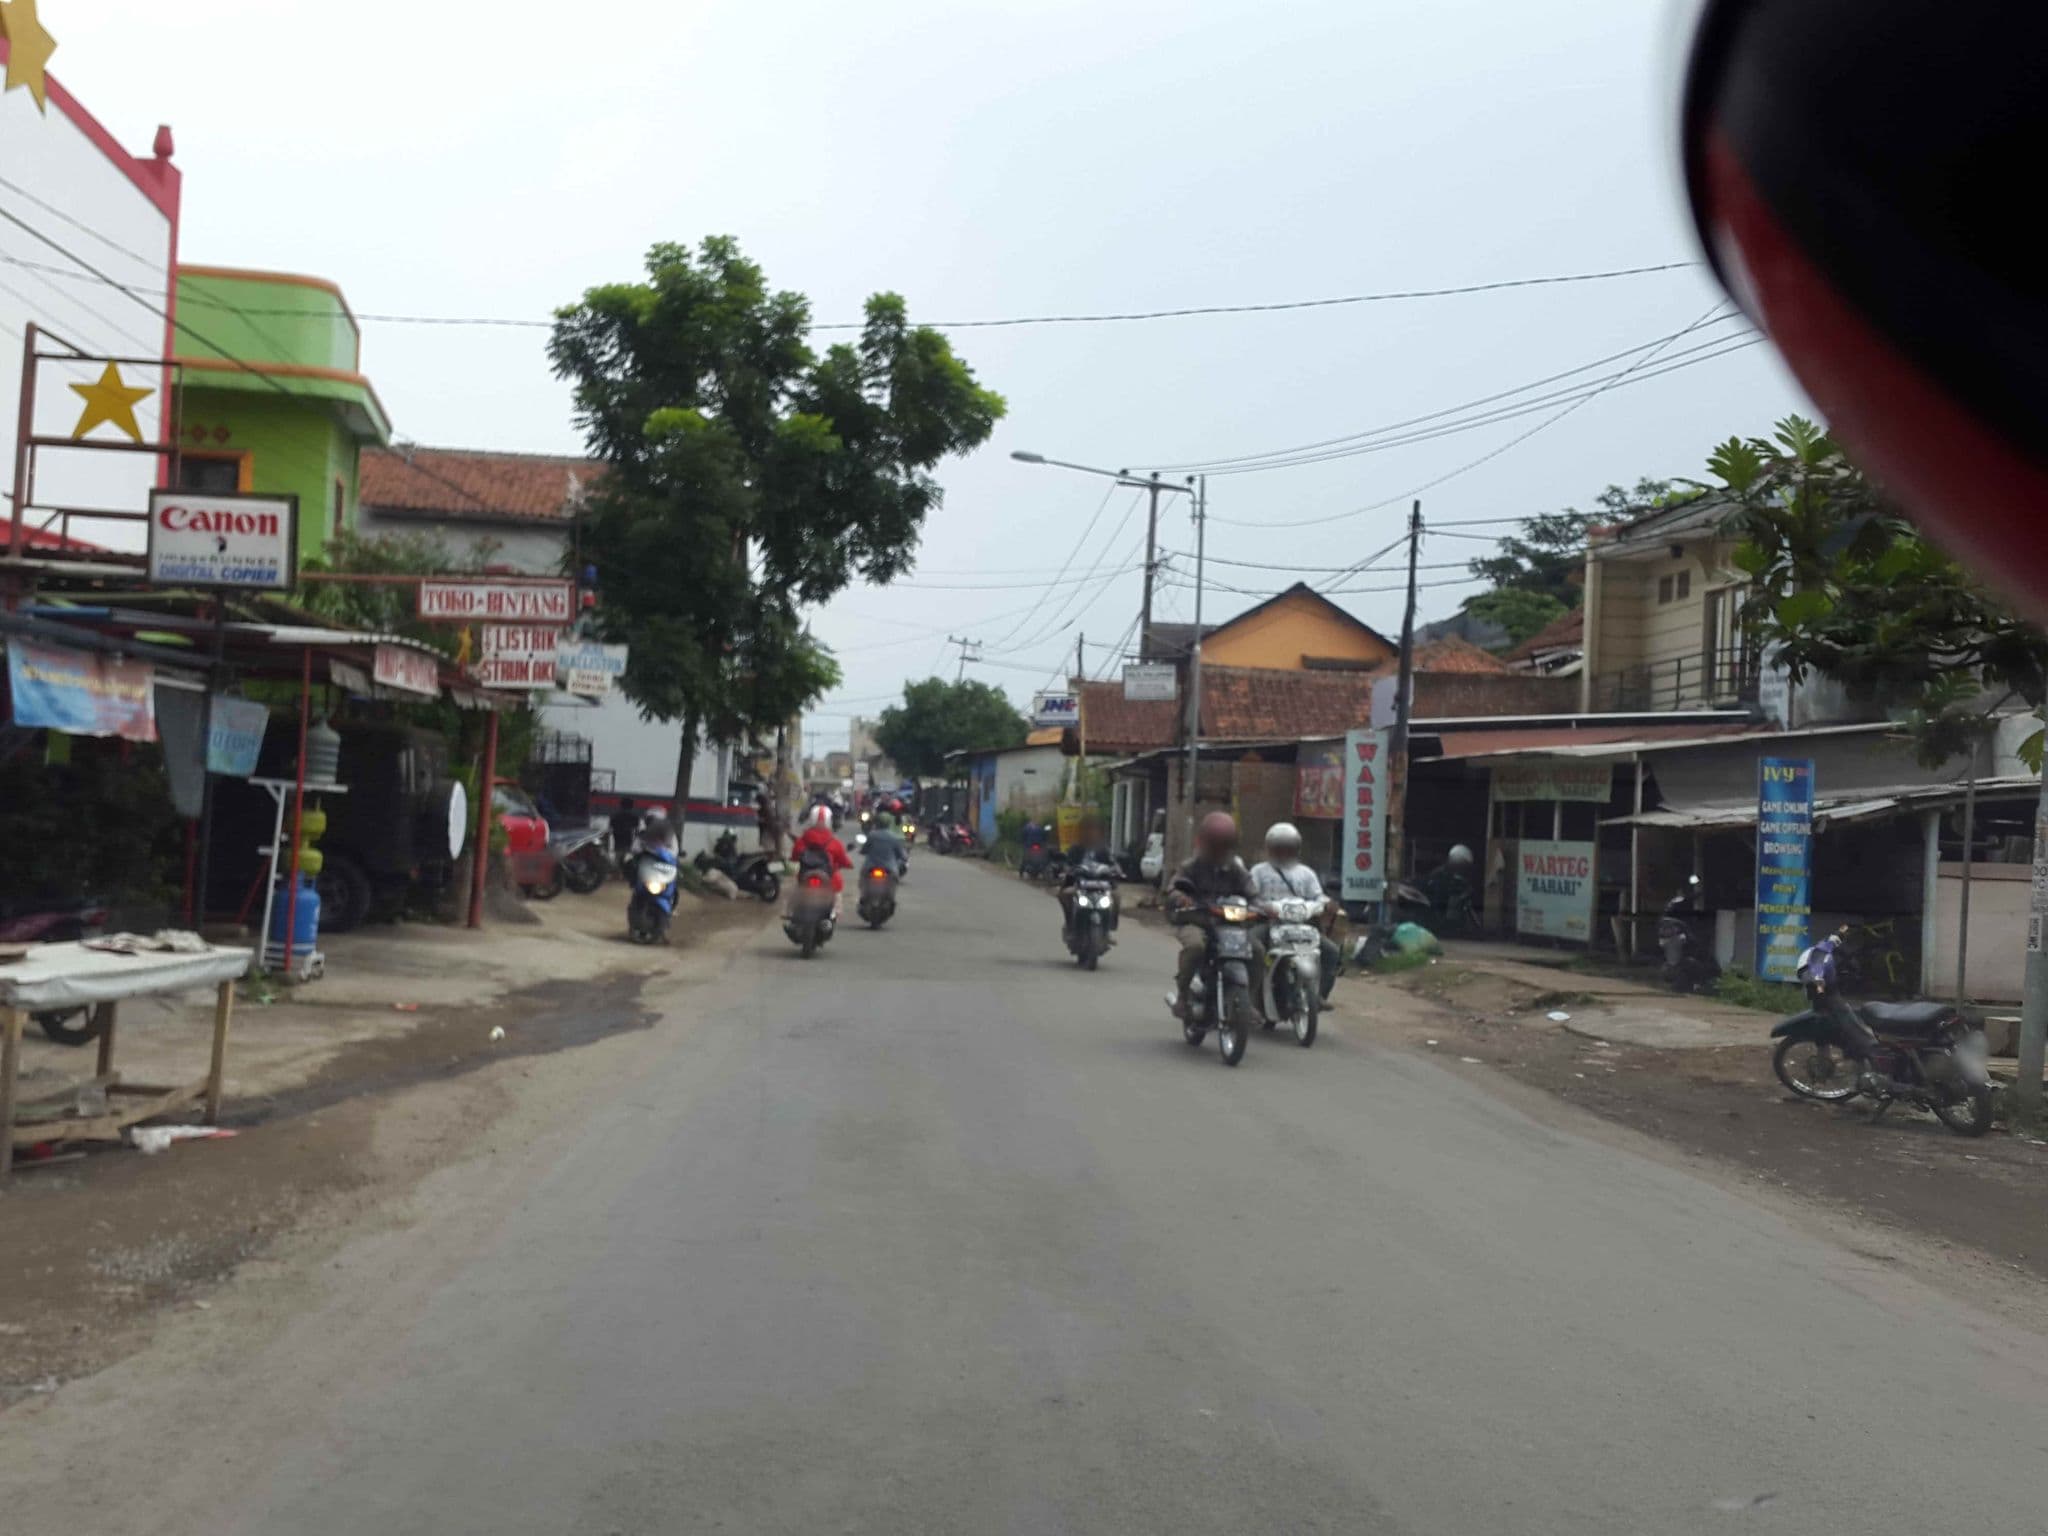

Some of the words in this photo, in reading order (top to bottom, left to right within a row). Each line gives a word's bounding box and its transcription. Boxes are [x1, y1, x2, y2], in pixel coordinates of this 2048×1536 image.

[159, 506, 278, 536] Canon
[159, 562, 215, 580] DIGITAL
[221, 565, 278, 582] COPIER
[426, 589, 475, 612] TOKO
[486, 590, 566, 615] BINTANG
[496, 628, 557, 651] LISTRIK
[1355, 743, 1378, 871] WARTEG
[1762, 801, 1782, 813] GAME
[1783, 802, 1808, 814] ONLINE
[1760, 822, 1781, 834] GAME
[1523, 854, 1589, 877] WARTEG
